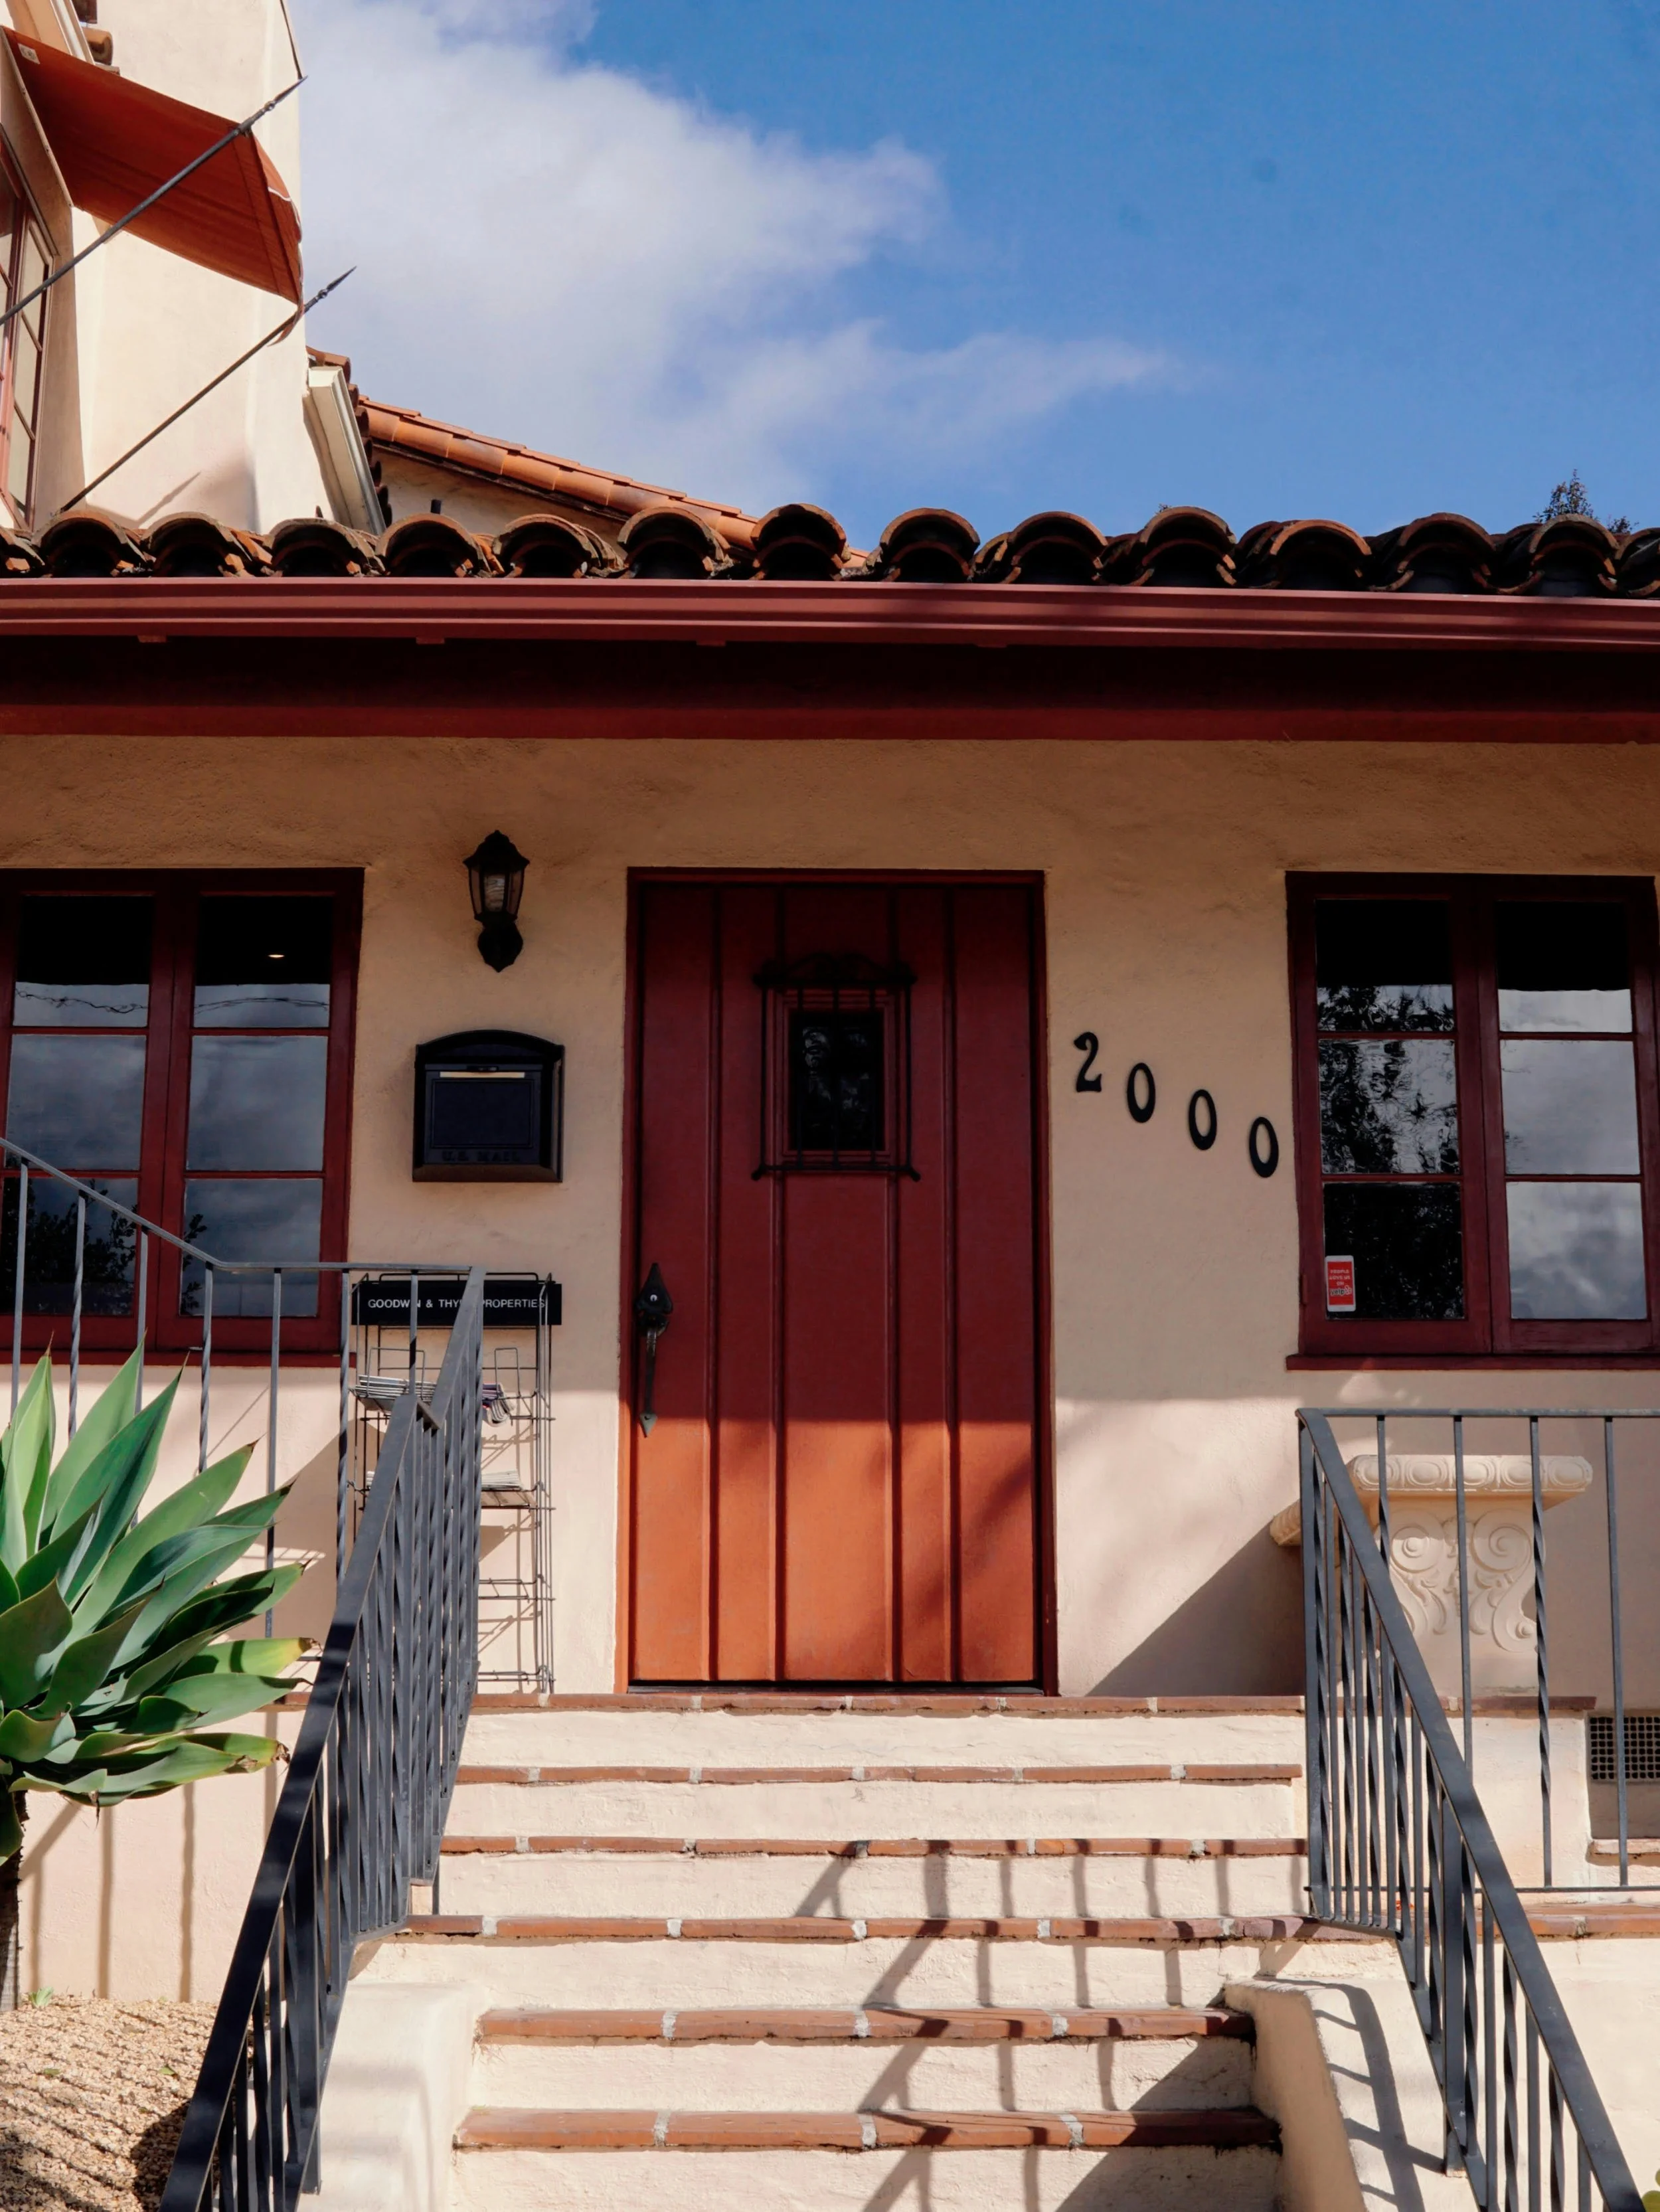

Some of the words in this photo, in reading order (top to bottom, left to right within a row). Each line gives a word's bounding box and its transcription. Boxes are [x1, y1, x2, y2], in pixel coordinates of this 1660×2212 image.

[1073, 1031, 1279, 1178] 2000
[477, 1151, 521, 1162] MAIL
[367, 1298, 421, 1309] GOODWN
[426, 1298, 434, 1308] &
